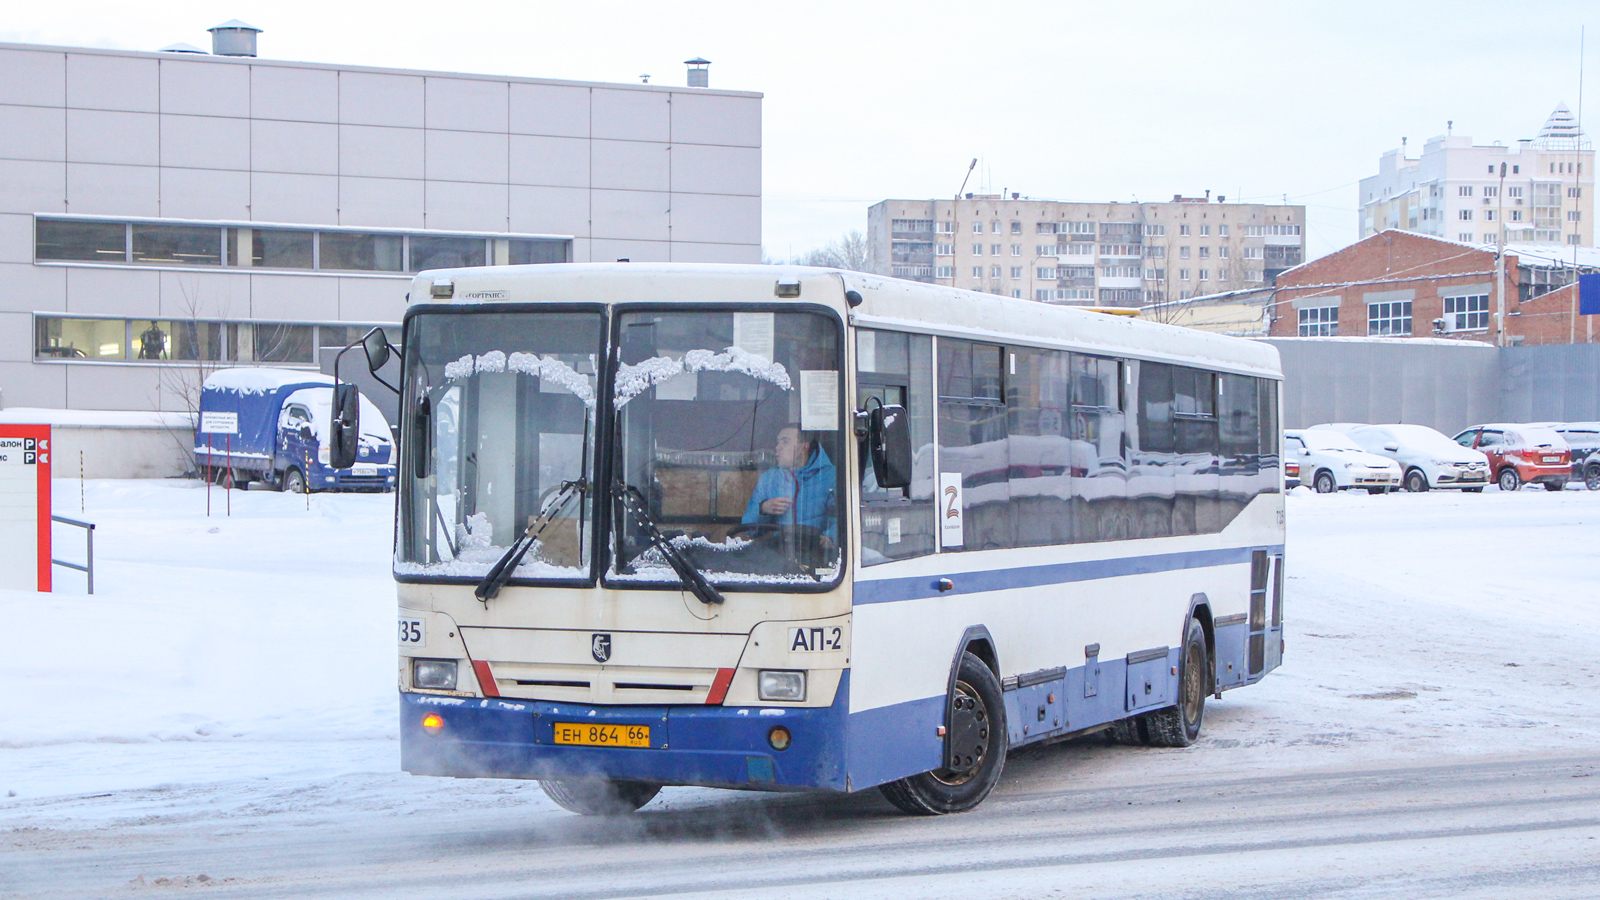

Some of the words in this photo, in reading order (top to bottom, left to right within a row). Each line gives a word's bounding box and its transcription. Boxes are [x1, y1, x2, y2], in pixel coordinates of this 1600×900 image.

[0, 440, 22, 448] алон
[791, 627, 842, 651] АП-2
[562, 728, 582, 742] ЕН
[588, 726, 619, 744] 864
[628, 726, 644, 740] 66
